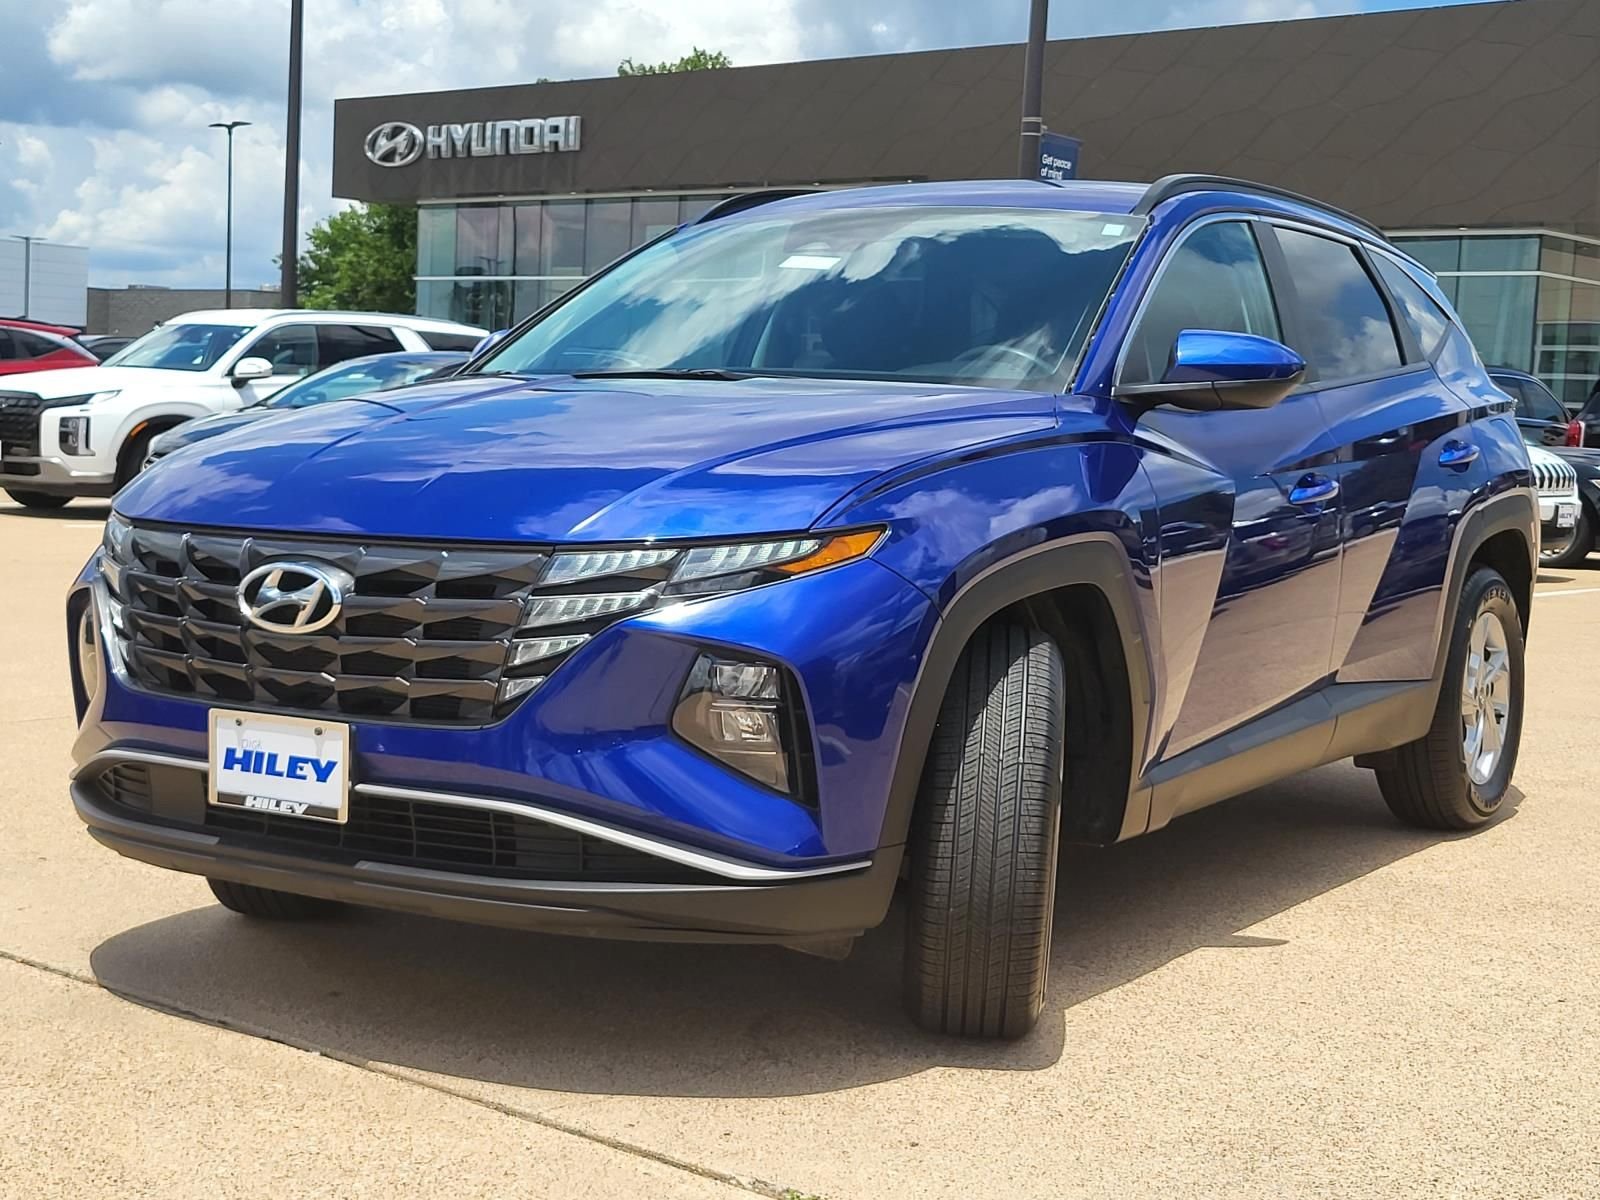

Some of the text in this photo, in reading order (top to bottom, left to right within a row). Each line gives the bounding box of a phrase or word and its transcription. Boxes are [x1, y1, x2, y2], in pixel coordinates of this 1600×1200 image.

[427, 115, 582, 159] HYUNDAI
[1041, 167, 1048, 176] of
[1042, 154, 1072, 169] Get peace
[1483, 586, 1510, 606] NEXEN
[223, 747, 338, 783] HILEY
[244, 795, 310, 815] HILEY
